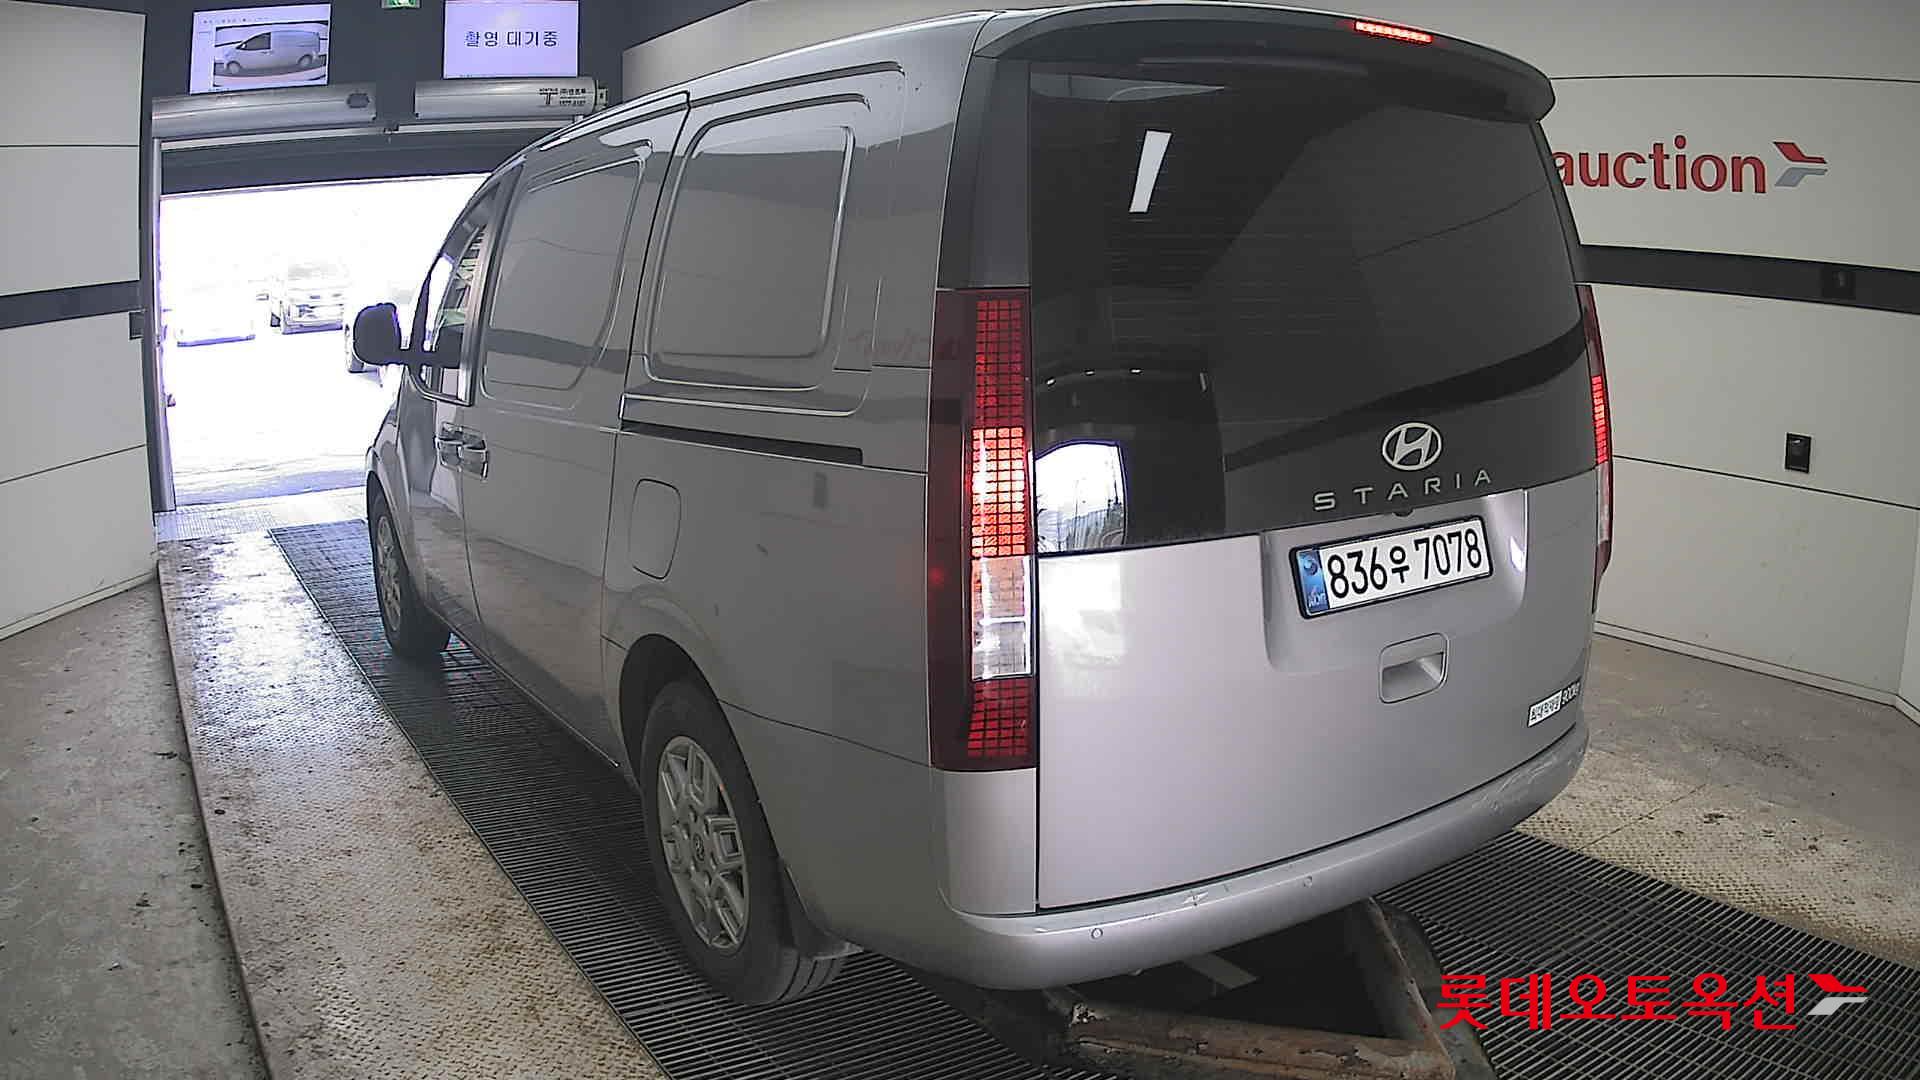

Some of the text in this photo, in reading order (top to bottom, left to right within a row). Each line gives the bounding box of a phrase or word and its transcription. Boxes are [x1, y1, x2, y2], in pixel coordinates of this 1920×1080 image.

[465, 31, 558, 48] 촬영 대기중
[1550, 134, 1767, 194] auction
[1313, 469, 1491, 511] STARIA
